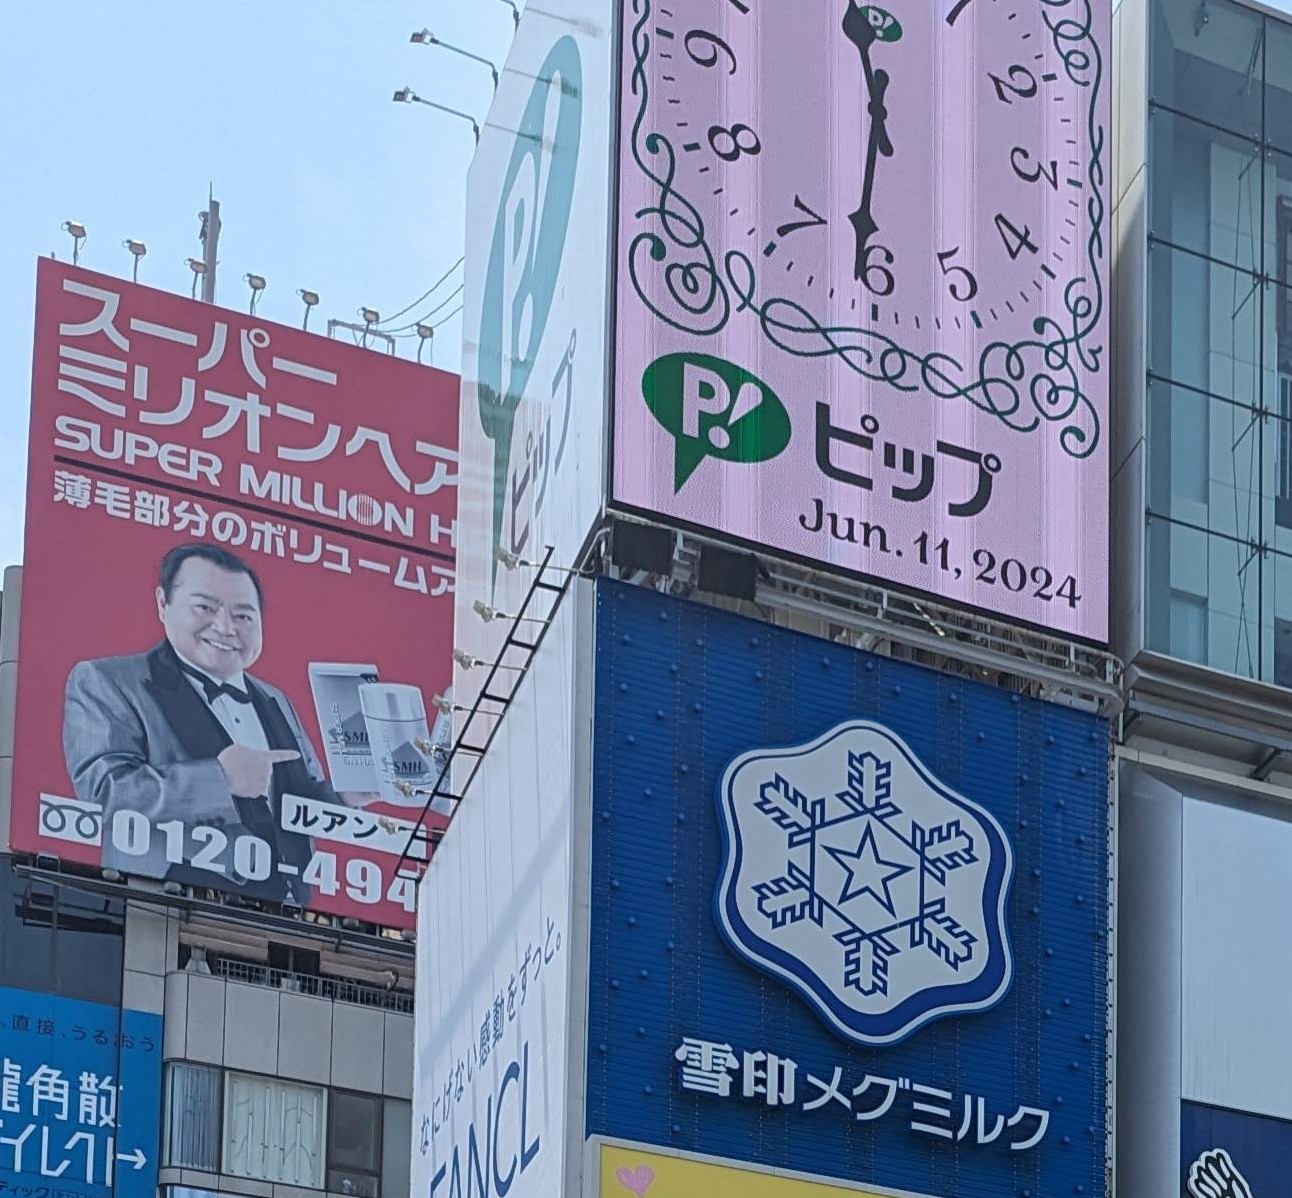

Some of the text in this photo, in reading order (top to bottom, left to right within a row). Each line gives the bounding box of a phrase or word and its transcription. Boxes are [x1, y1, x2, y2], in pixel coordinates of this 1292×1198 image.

[684, 28, 737, 75] 9
[988, 64, 1039, 106] 2
[708, 123, 761, 163] 8
[1010, 146, 1060, 191] 3
[777, 195, 828, 238] 7
[994, 212, 1039, 260] 4
[862, 245, 896, 297] 6
[937, 246, 978, 302] 5
[59, 278, 337, 388] スーパー
[511, 328, 578, 554] ピップ
[815, 401, 1003, 517] ピップ
[54, 416, 222, 487] SUPER
[240, 464, 414, 538] MILLION
[799, 499, 1083, 609] Jun. 11, 2024
[419, 916, 562, 1156] なにげない感動をずっと。
[674, 1036, 1050, 1151] 雪印メグミルク
